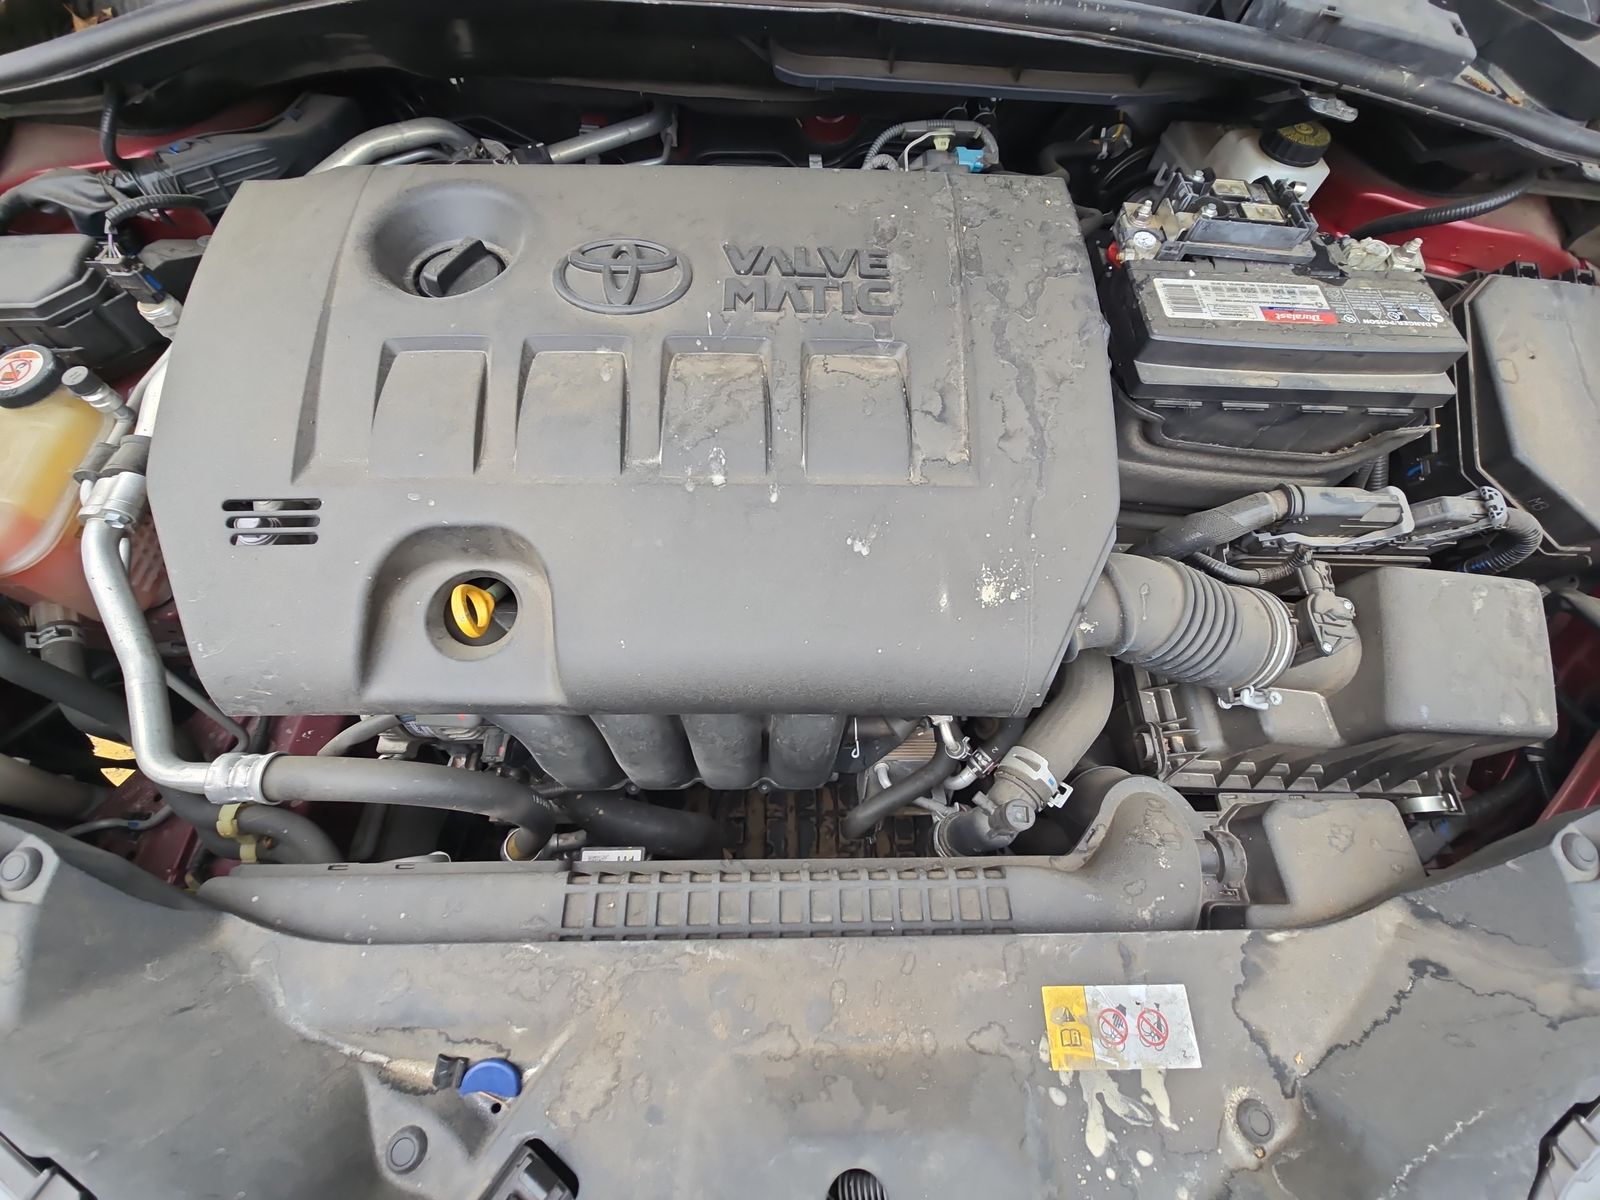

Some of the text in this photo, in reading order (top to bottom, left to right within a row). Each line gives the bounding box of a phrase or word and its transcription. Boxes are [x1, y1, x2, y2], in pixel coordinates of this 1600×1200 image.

[722, 244, 890, 279] VALVE
[723, 277, 894, 316] MATIC
[1274, 312, 1324, 322] Duralast
